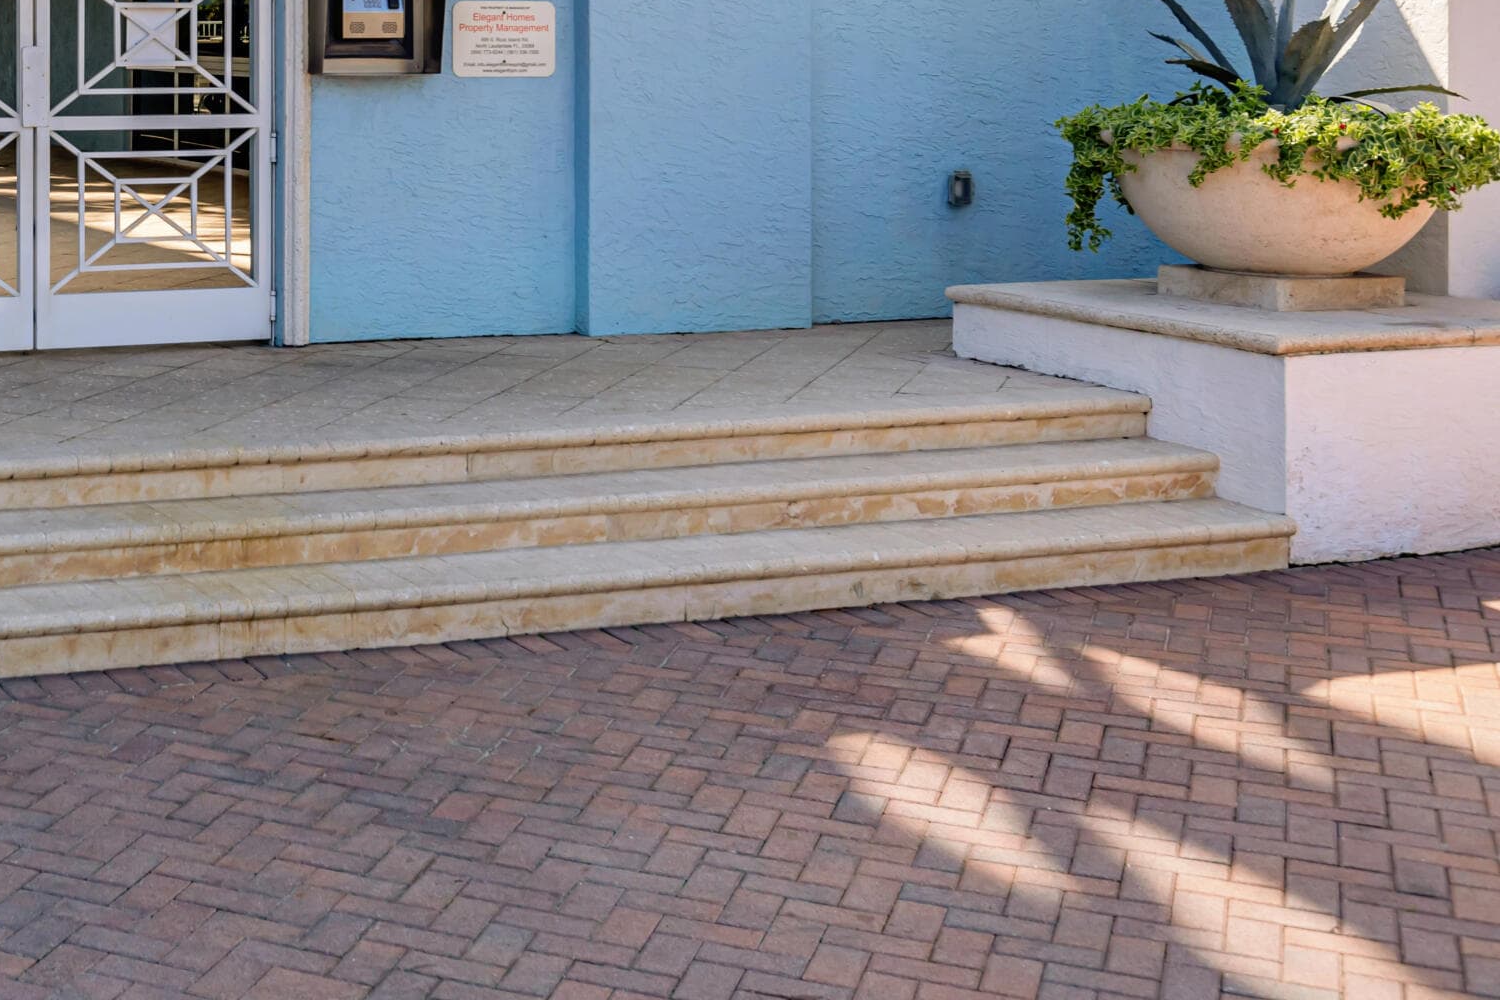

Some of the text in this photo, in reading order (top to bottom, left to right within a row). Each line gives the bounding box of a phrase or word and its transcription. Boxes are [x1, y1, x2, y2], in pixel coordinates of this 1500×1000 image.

[472, 12, 536, 22] Elegant Homes
[459, 23, 548, 33] Property Management
